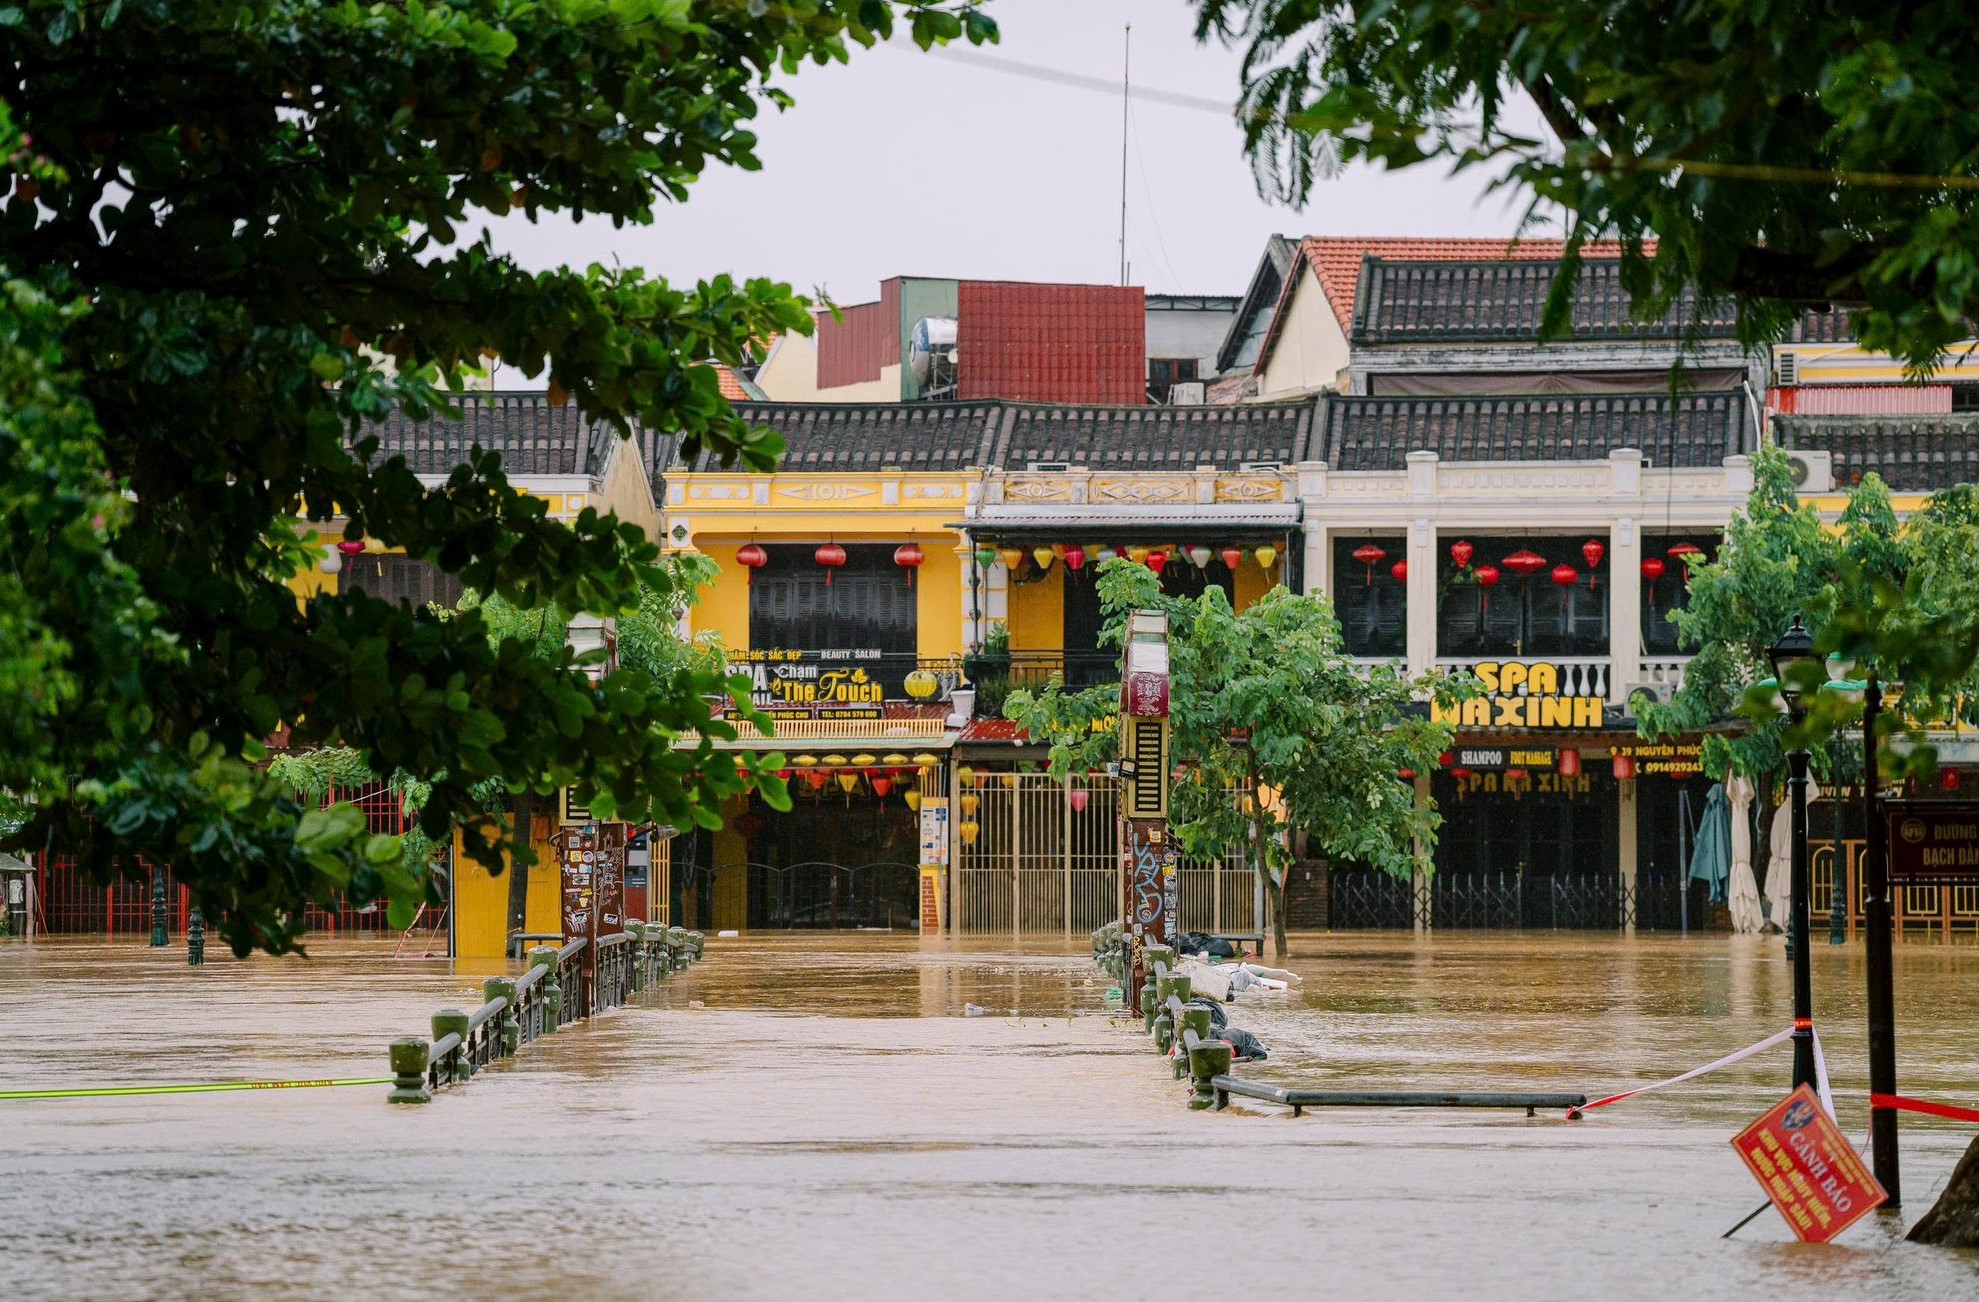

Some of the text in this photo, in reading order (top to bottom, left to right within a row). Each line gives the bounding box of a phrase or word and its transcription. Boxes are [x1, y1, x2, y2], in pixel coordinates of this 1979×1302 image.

[821, 650, 881, 659] BEAUTY SALON
[775, 664, 819, 681] Chạm
[1474, 661, 1557, 694] SPA
[783, 667, 883, 703] The Touch
[1461, 751, 1502, 765] SHAMPOO
[1510, 751, 1552, 765] FOOT MASSAGE
[1621, 746, 1632, 756] 39
[1923, 847, 1955, 868] BẠCH
[1789, 1132, 1829, 1179] CẢNH
[1820, 1175, 1852, 1213] BÁO
